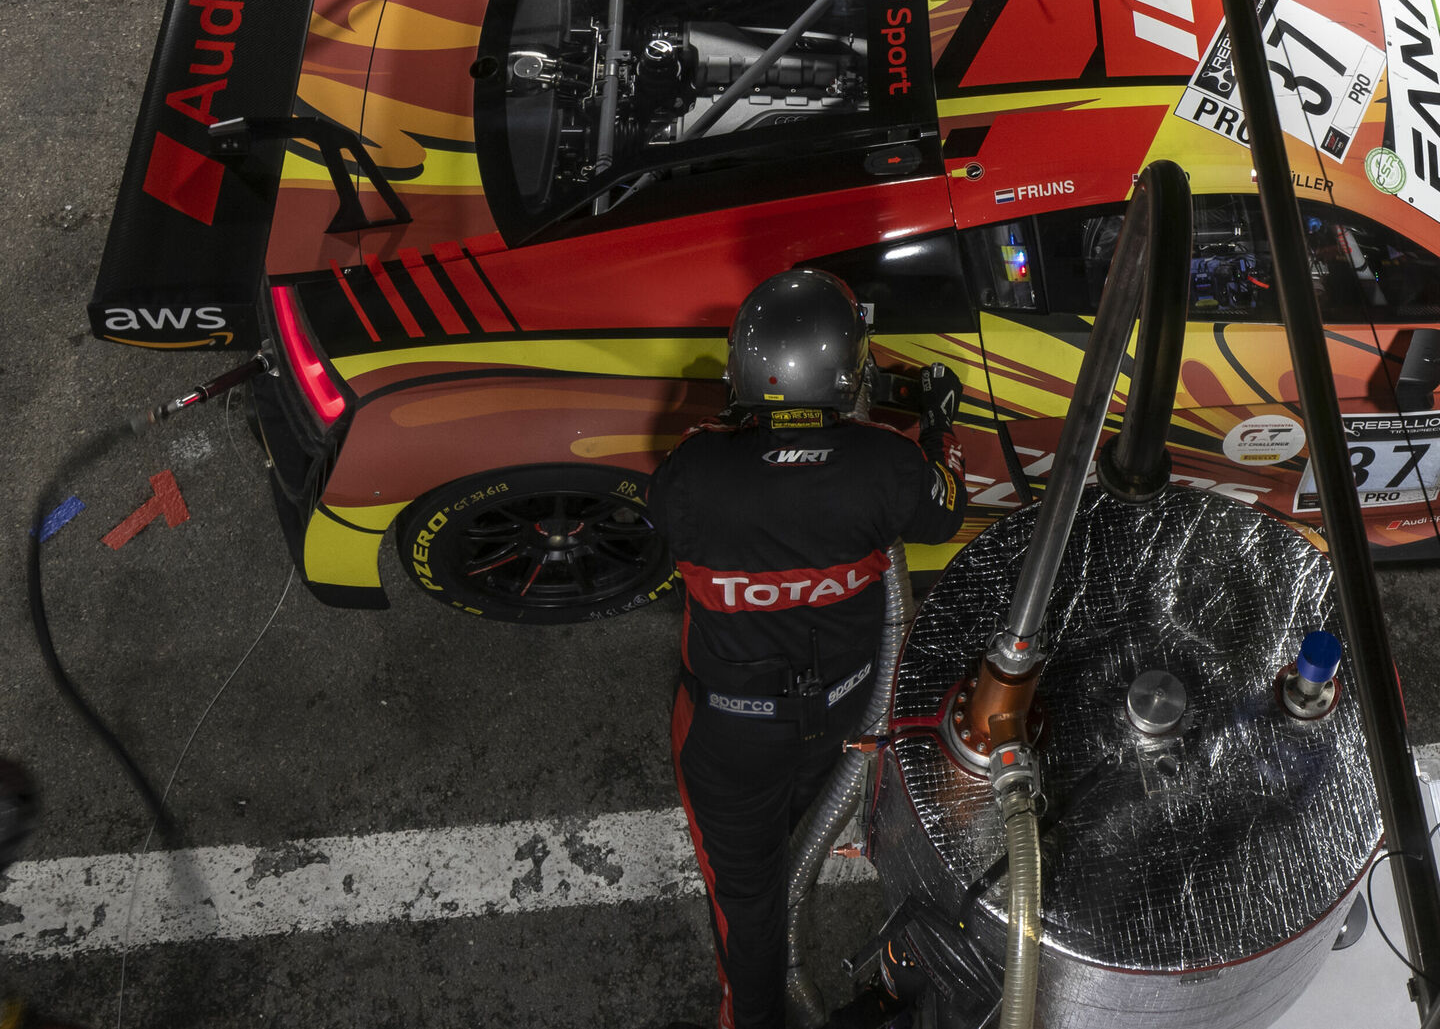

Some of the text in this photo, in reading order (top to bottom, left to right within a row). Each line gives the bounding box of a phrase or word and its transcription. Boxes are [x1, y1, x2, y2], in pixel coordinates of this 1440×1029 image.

[881, 8, 912, 95] Sport
[1348, 73, 1371, 105] PRO
[1017, 180, 1075, 200] FRIJNS
[105, 307, 226, 330] aws
[776, 448, 834, 463] WRT
[616, 480, 637, 495] RR
[1364, 492, 1400, 503] PRO
[1401, 517, 1427, 527] Audi
[712, 569, 870, 606] TOTAL
[828, 662, 871, 702] sparco
[709, 693, 774, 712] sparco
